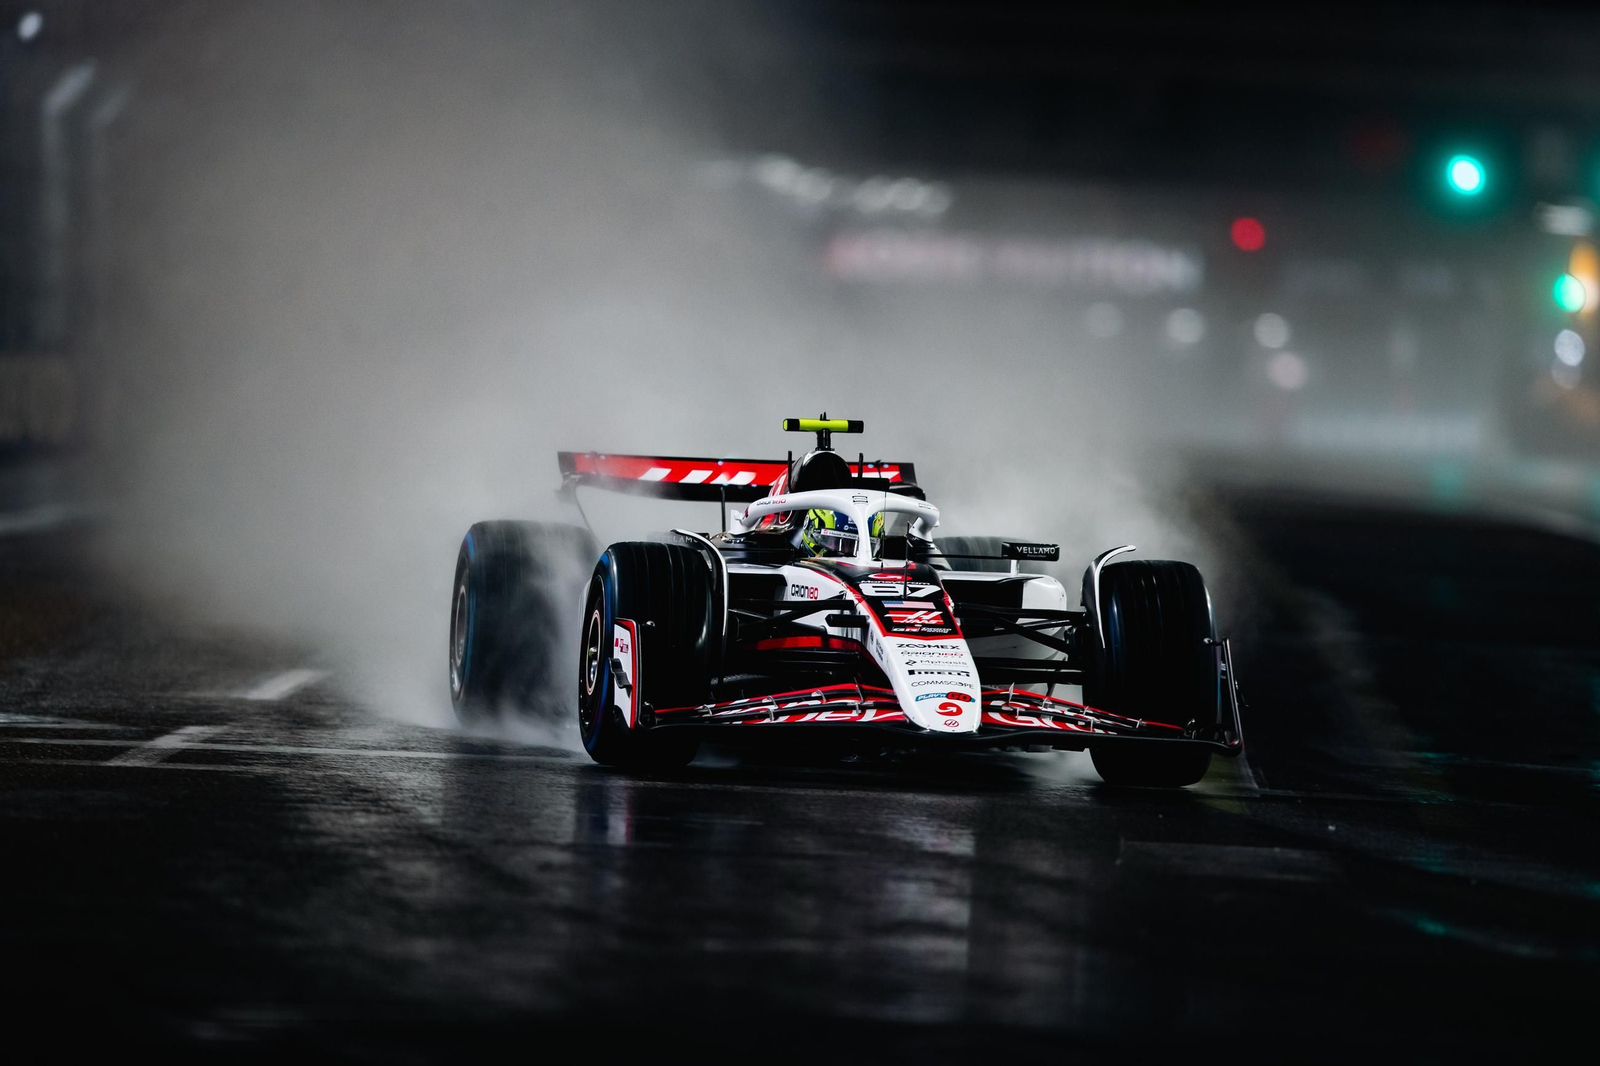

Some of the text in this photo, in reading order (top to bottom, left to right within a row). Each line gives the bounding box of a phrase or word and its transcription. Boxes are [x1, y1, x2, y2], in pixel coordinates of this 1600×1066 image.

[1016, 546, 1056, 554] VELLAMO
[791, 583, 819, 600] ORION180
[858, 583, 942, 598] 87
[908, 669, 970, 678] PIRELLI
[911, 680, 974, 690] COMMSCOPE
